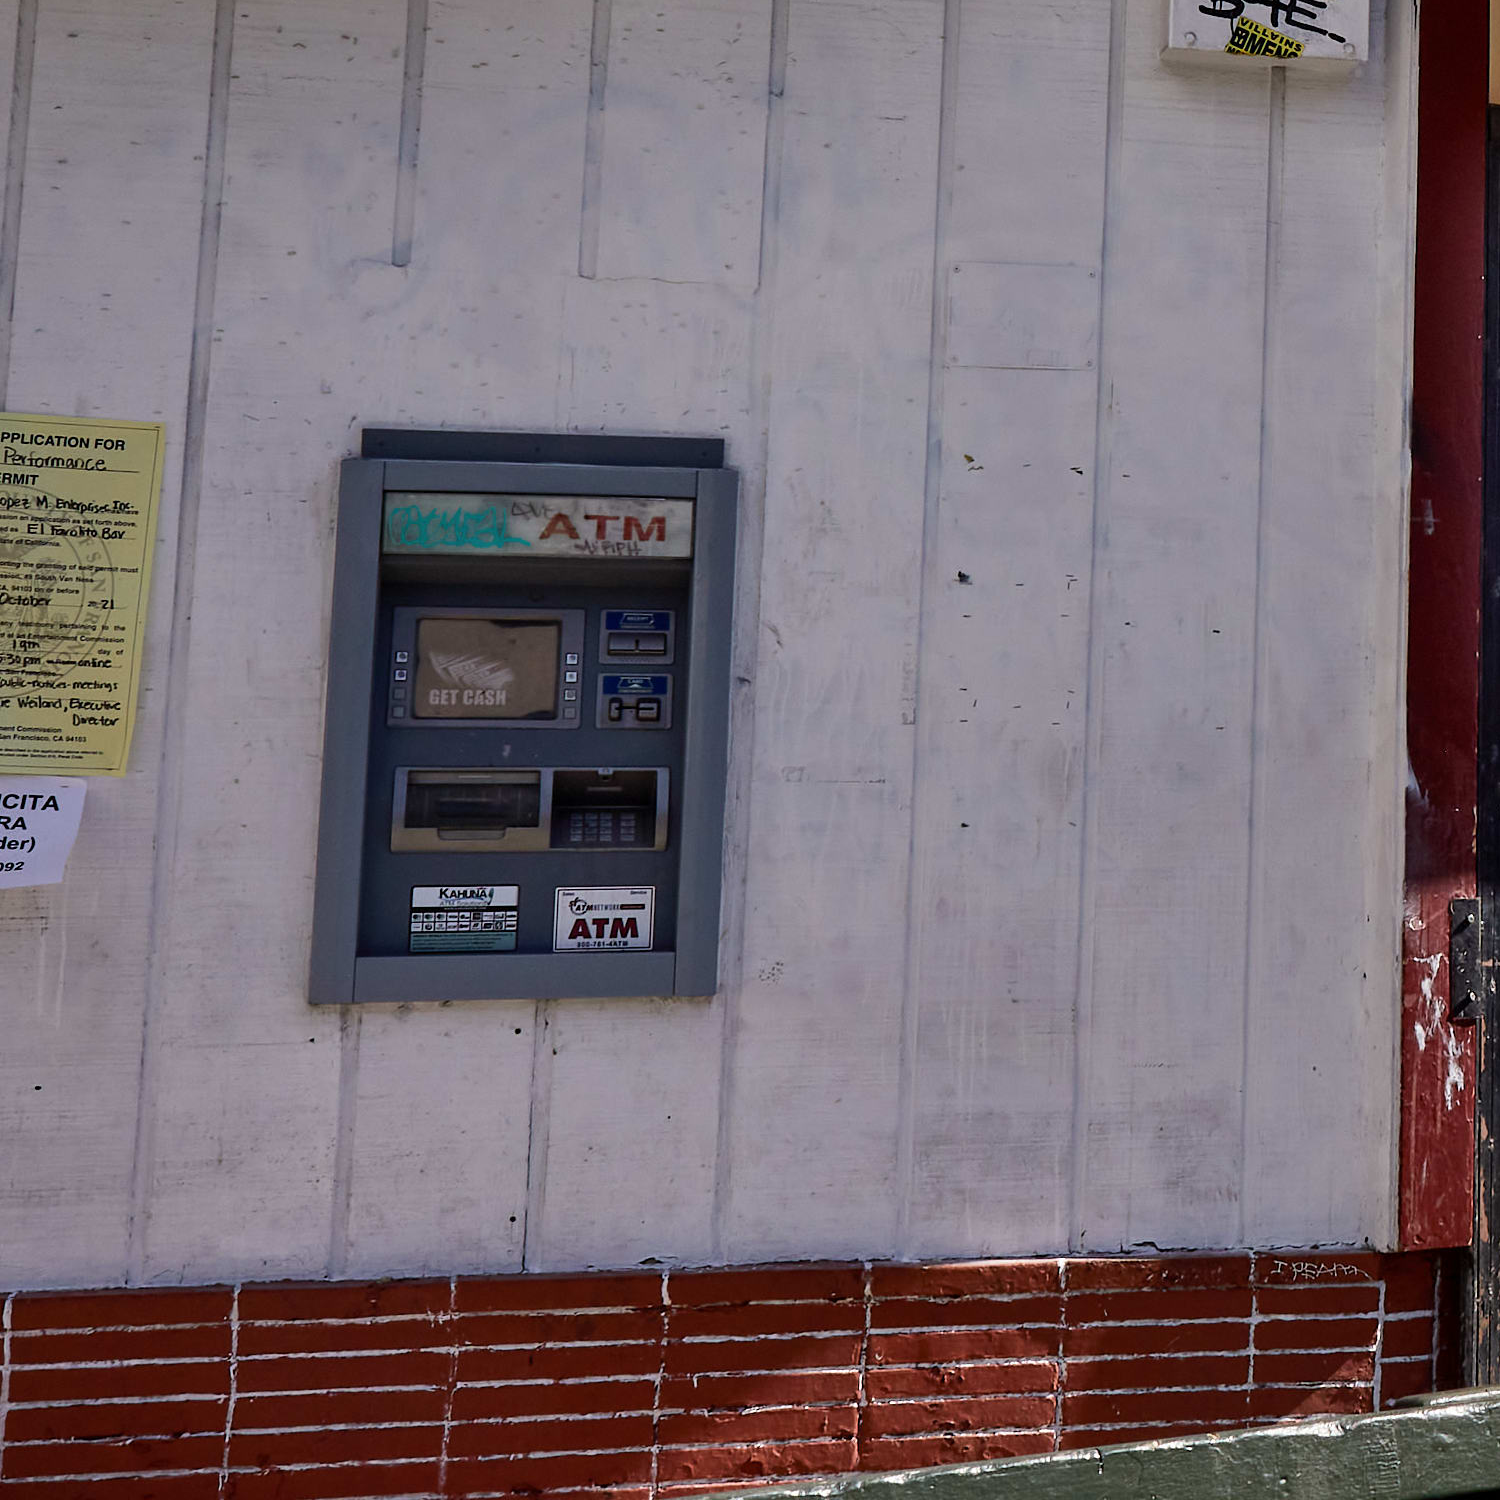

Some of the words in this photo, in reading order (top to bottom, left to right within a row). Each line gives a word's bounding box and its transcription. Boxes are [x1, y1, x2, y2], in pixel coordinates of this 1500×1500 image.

[94, 439, 126, 451] FOR
[4, 446, 107, 471] Performance
[0, 473, 39, 486] RMIT
[539, 512, 667, 542] ATM
[97, 648, 111, 656] day
[429, 689, 460, 705] GET
[463, 690, 507, 706] CASH
[17, 726, 62, 734] Commission
[53, 735, 64, 743] CA
[439, 888, 488, 899] KAHUNA
[568, 917, 639, 940] ATM
